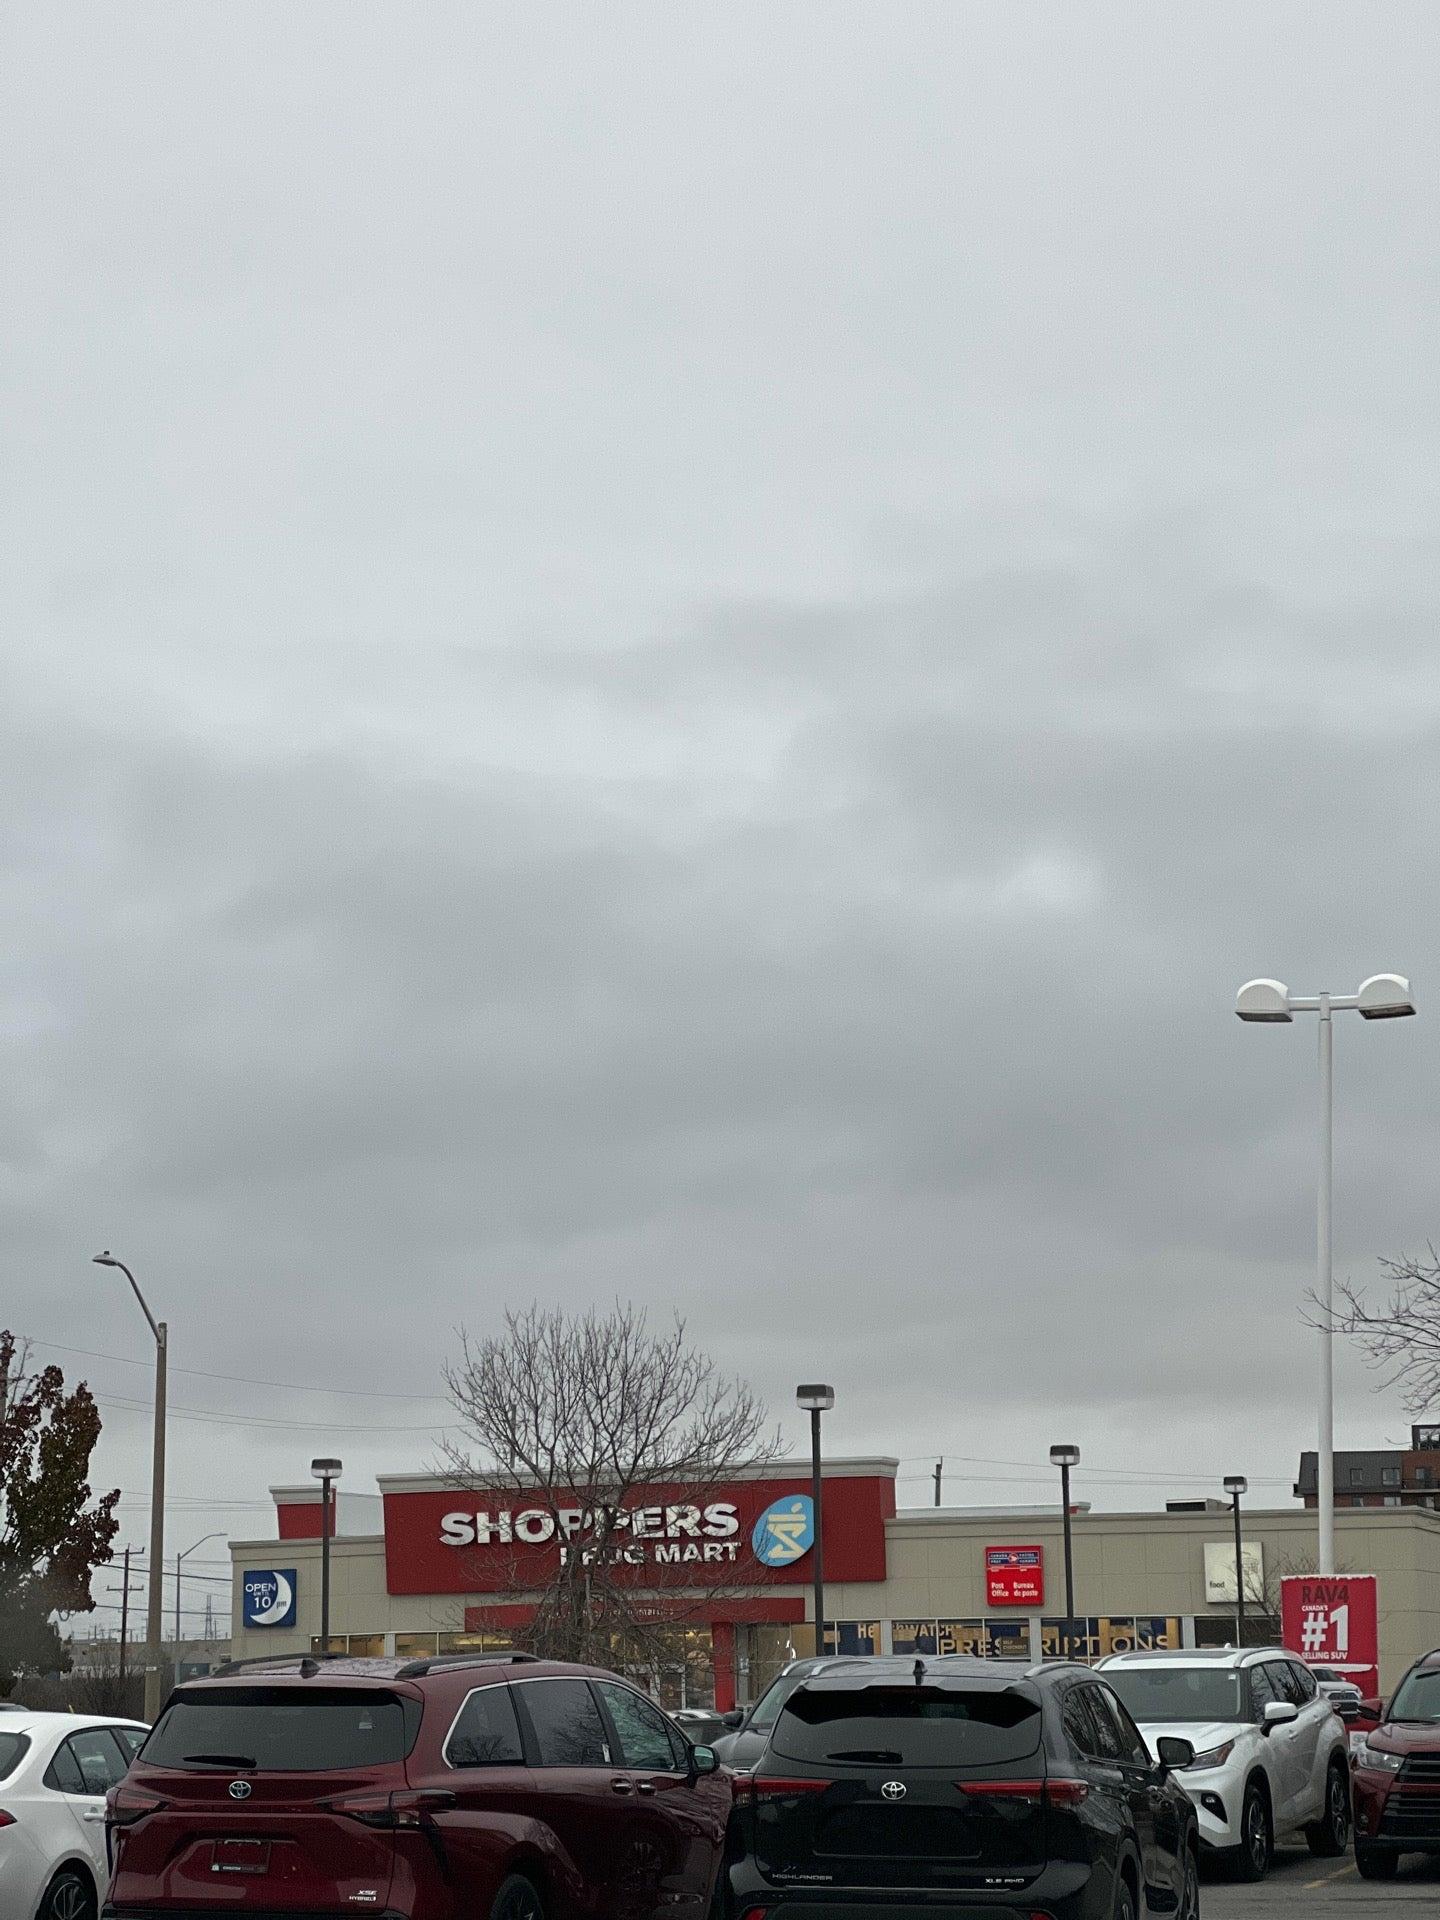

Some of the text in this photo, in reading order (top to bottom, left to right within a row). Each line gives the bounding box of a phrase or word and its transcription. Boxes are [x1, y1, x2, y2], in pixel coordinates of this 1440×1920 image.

[439, 1503, 739, 1546] SHOPPERS
[655, 1541, 741, 1563] MART
[245, 1583, 276, 1592] OPEN
[1209, 1581, 1225, 1589] food
[1302, 1585, 1349, 1603] RAV4
[254, 1597, 271, 1608] 10
[1302, 1605, 1348, 1651] #1
[1302, 1651, 1348, 1660] SELLING SUV
